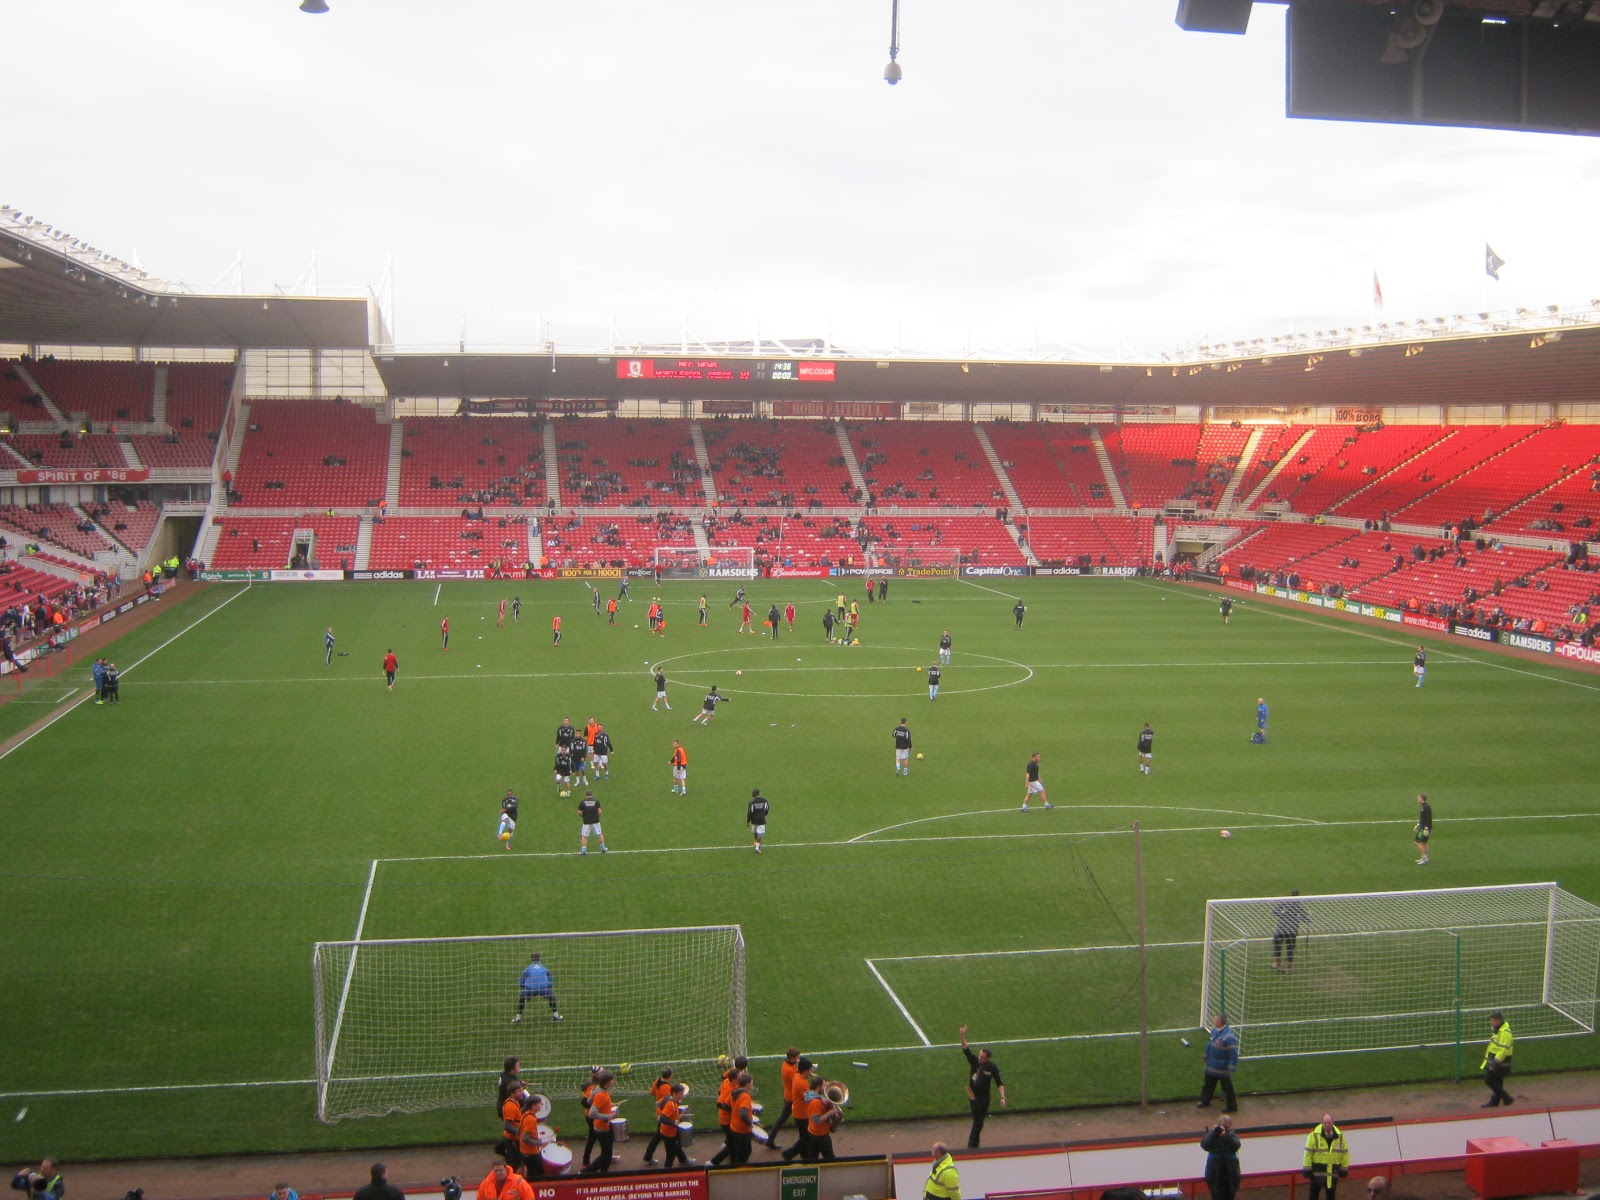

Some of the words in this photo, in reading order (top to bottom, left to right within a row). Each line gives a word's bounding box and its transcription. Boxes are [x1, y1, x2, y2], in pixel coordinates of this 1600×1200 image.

[772, 371, 792, 380] 00:00
[552, 401, 596, 410] BORO
[792, 403, 823, 415] BORO
[825, 403, 882, 416] FAITHFUL
[1356, 413, 1380, 422] BORO
[38, 470, 77, 482] SPIRIT
[84, 470, 100, 481] OF
[107, 470, 127, 481] '86
[373, 570, 404, 579] adidas
[598, 569, 621, 578] HOOCH
[709, 568, 758, 577] RAMSDENS
[770, 567, 822, 577] Budweiser
[849, 568, 893, 576] POWERADE
[907, 567, 952, 576] TradePoint
[1053, 566, 1080, 575] adidas
[201, 572, 223, 580] Carlsberg
[1256, 583, 1287, 598] bet365.com
[1289, 589, 1322, 606] bet365.com
[1324, 597, 1359, 613] bet365.com
[1361, 605, 1401, 622] bet365.com
[1403, 616, 1446, 631] www.mfc.co.uk
[1467, 628, 1491, 641] adidas
[1510, 635, 1552, 652] RAMSDENS
[782, 1174, 817, 1185] EMERGENCY
[599, 1184, 634, 1192] ARRESTABLE
[635, 1182, 660, 1190] OFFENCE
[669, 1180, 687, 1188] ENTER
[539, 1188, 556, 1198] NO
[628, 1191, 652, 1200] (BEYOND
[653, 1190, 665, 1198] THE
[665, 1189, 691, 1198] BARRIER)
[792, 1188, 807, 1197] EXIT
